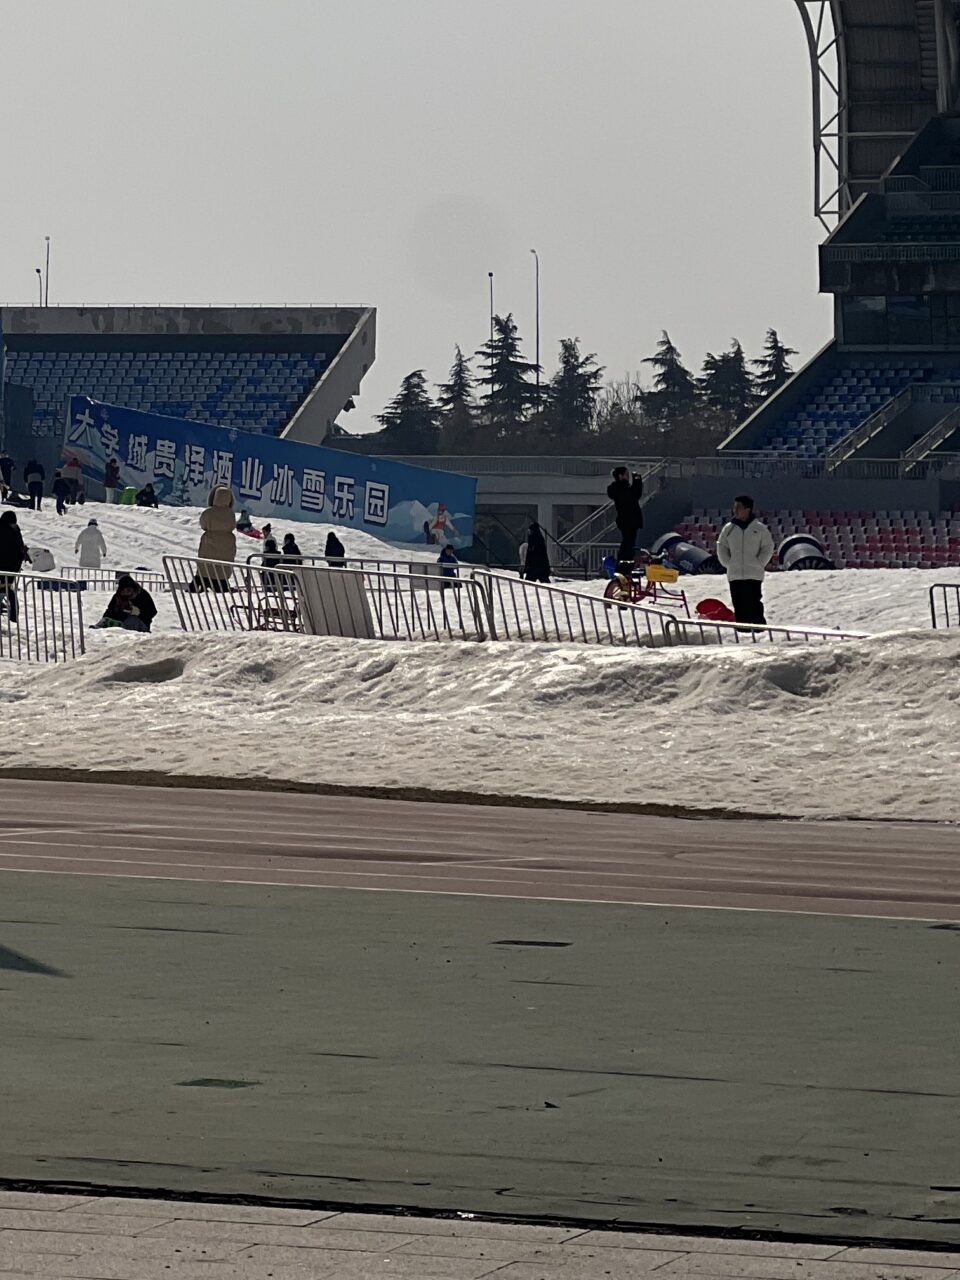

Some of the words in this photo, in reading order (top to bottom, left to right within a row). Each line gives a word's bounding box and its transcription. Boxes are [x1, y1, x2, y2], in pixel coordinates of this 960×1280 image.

[68, 410, 390, 524] 大学城贵泽酒业冰雪乐园
